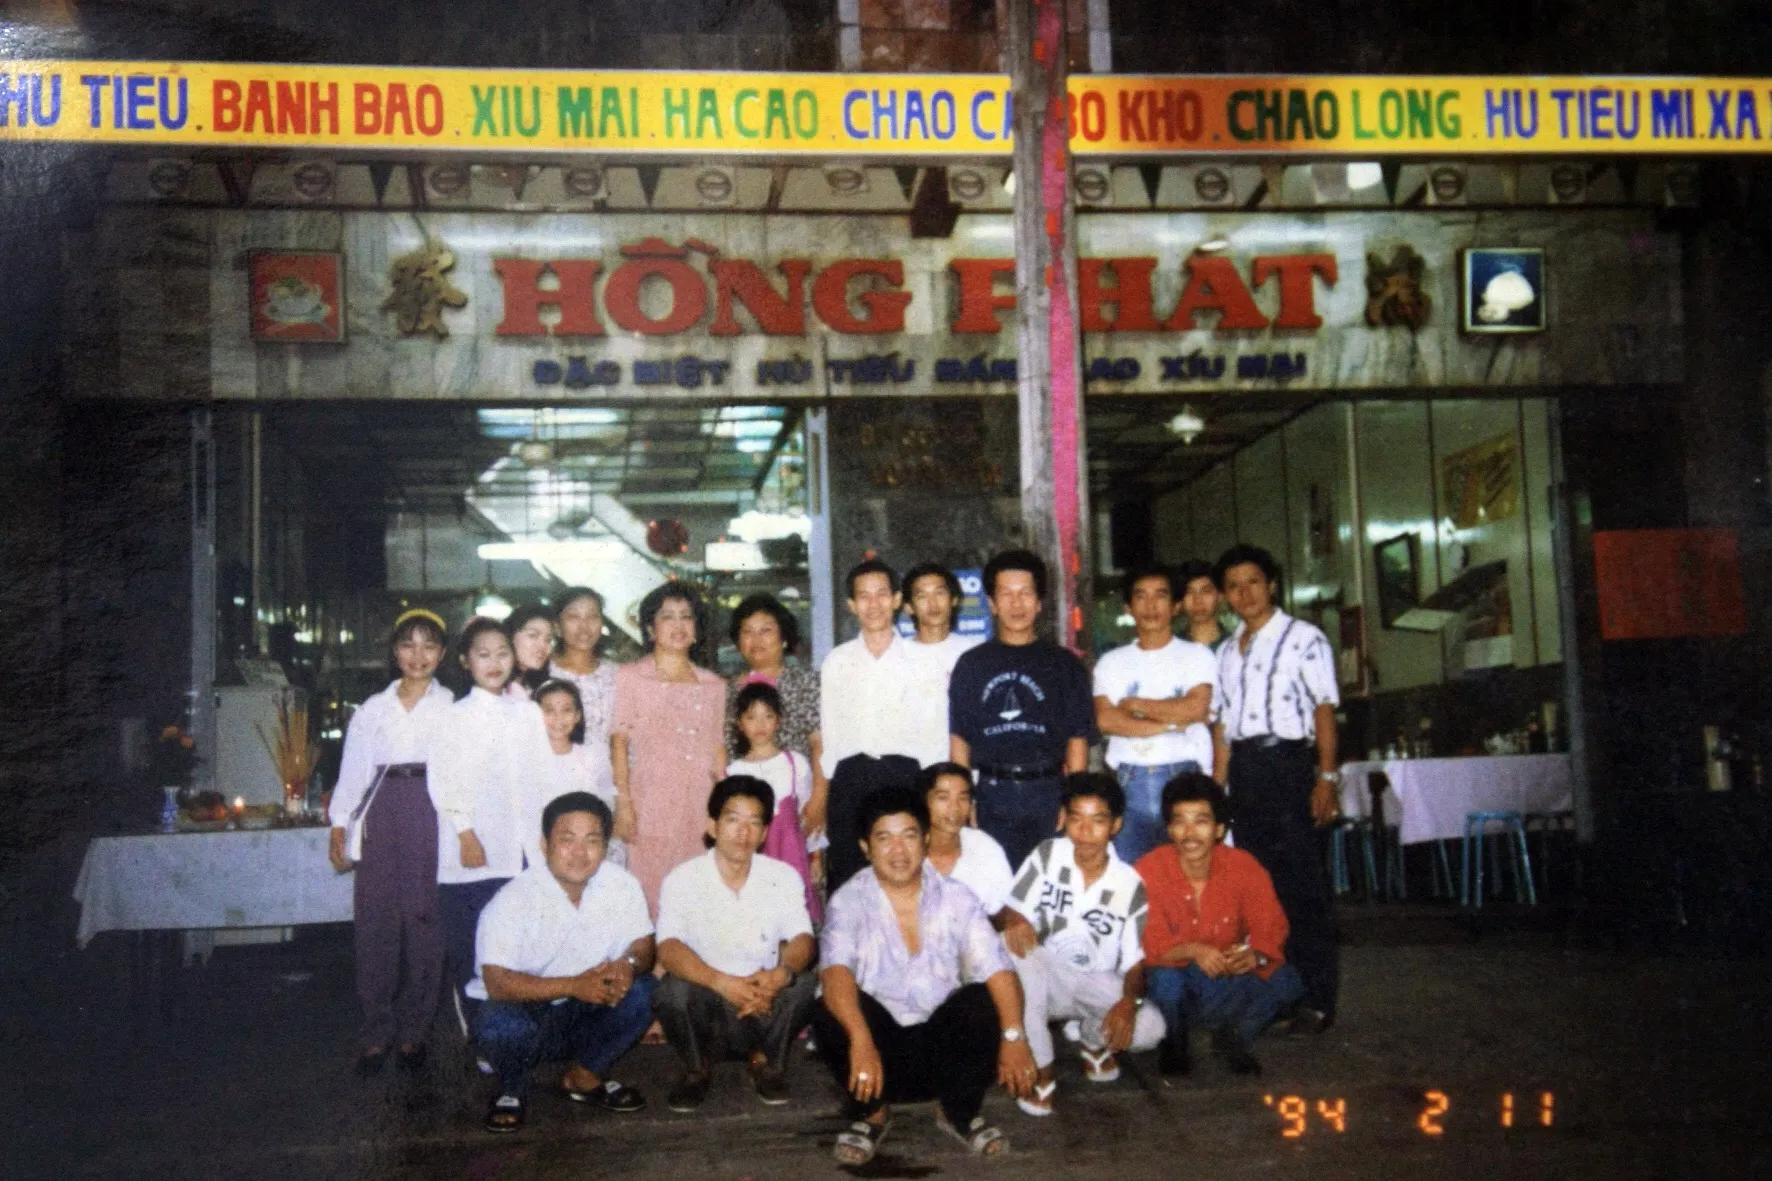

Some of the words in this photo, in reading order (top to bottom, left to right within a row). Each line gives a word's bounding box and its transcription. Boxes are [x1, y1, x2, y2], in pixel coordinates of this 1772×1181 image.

[0, 73, 61, 127] HU
[213, 80, 340, 135] BANH
[471, 85, 541, 137] XIU
[664, 88, 724, 139] HA
[844, 89, 957, 141] CHAO
[1227, 89, 1339, 141] CHAO
[1486, 90, 1538, 139] HU
